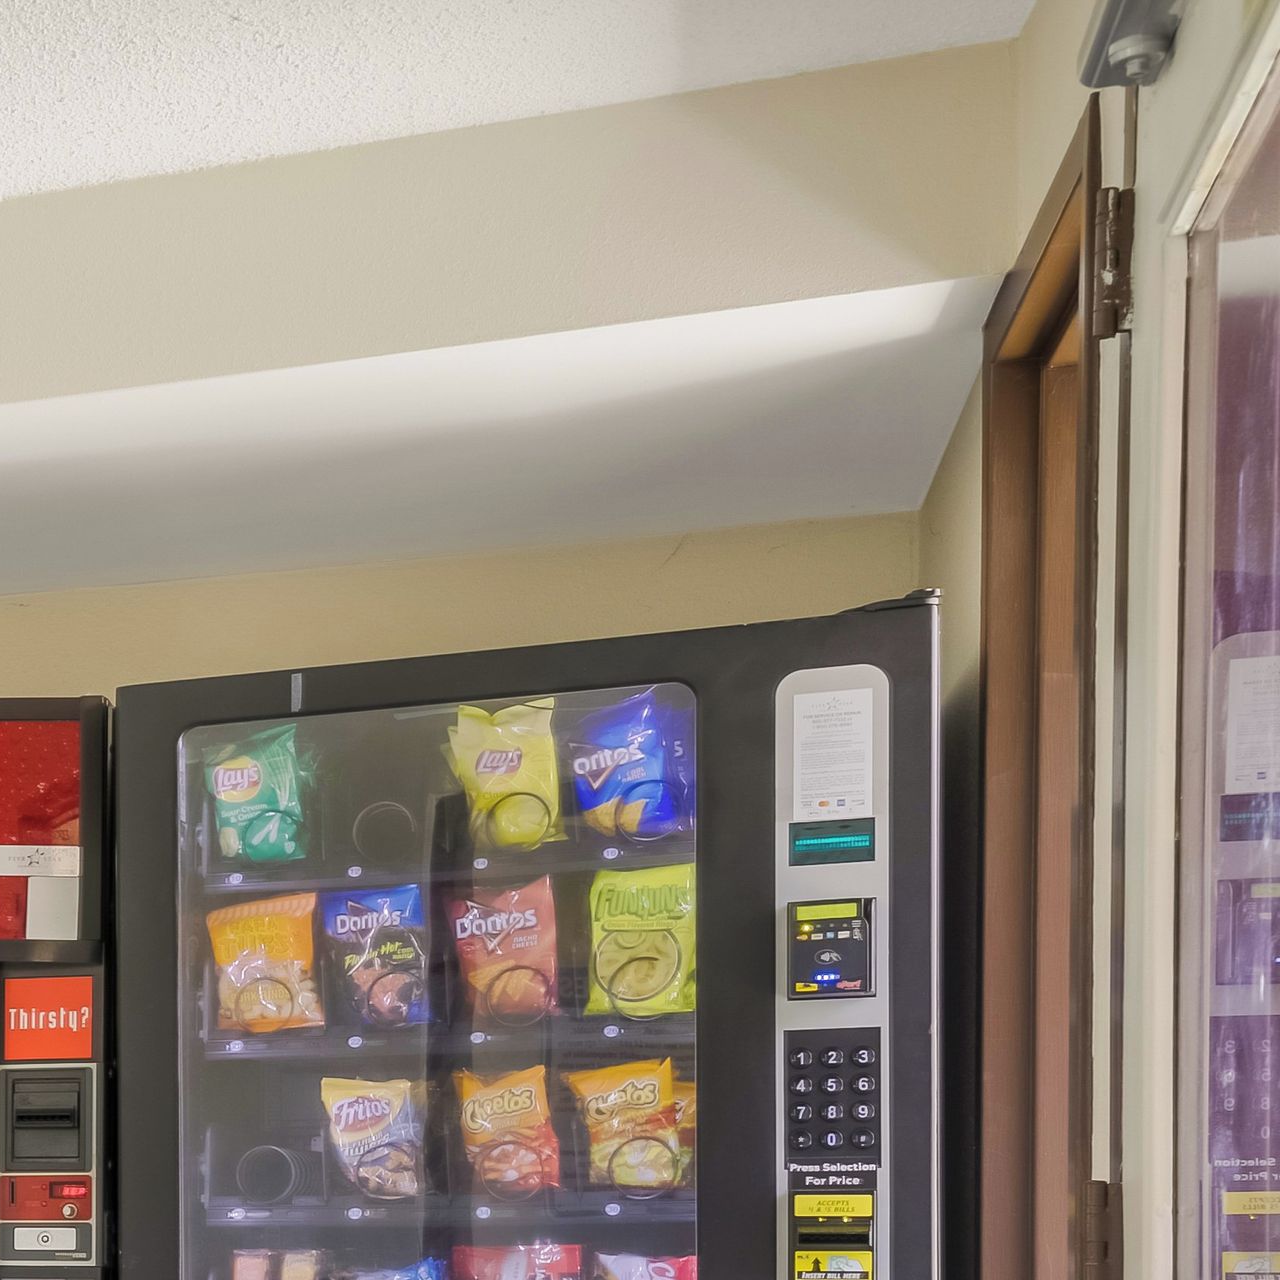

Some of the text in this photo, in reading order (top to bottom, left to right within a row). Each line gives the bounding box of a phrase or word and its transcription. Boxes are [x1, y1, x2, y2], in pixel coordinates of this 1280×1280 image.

[476, 749, 522, 773] Lay's
[573, 741, 646, 775] oritos
[336, 911, 402, 935] Doritos
[456, 908, 538, 939] Doritos
[512, 940, 539, 949] CHEESE
[9, 1006, 89, 1031] Thirsty?
[798, 1050, 868, 1064] 1 2 3
[796, 1078, 868, 1092] 4 5 6
[333, 1096, 390, 1132] Fritos
[464, 1088, 533, 1131] Cheetos
[797, 1105, 868, 1119] 7 8 9
[789, 1162, 876, 1172] Press Selection
[805, 1175, 860, 1185] For Price
